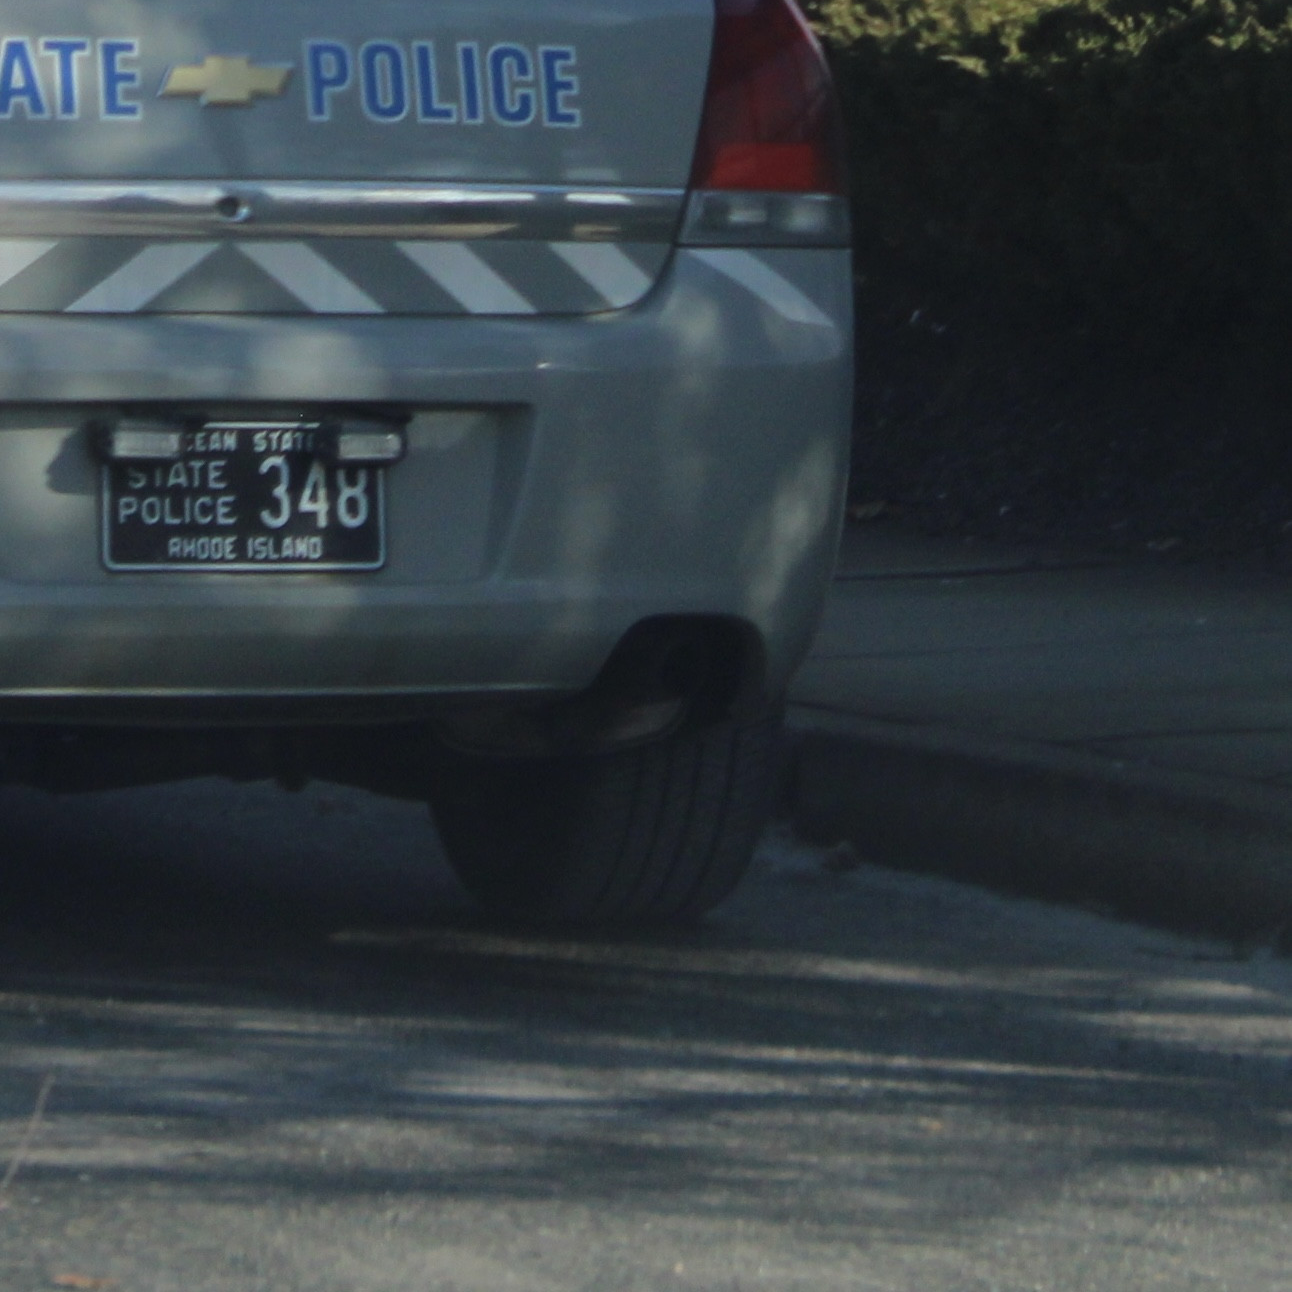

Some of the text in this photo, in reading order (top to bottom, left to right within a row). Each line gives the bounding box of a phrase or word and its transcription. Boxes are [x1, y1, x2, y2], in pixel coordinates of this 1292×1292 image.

[303, 37, 583, 128] POLICE
[253, 431, 313, 453] STAT
[127, 461, 229, 490] STATE
[258, 455, 369, 529] 348
[119, 494, 239, 526] POLICE
[168, 537, 324, 559] RHODE ISLAND
